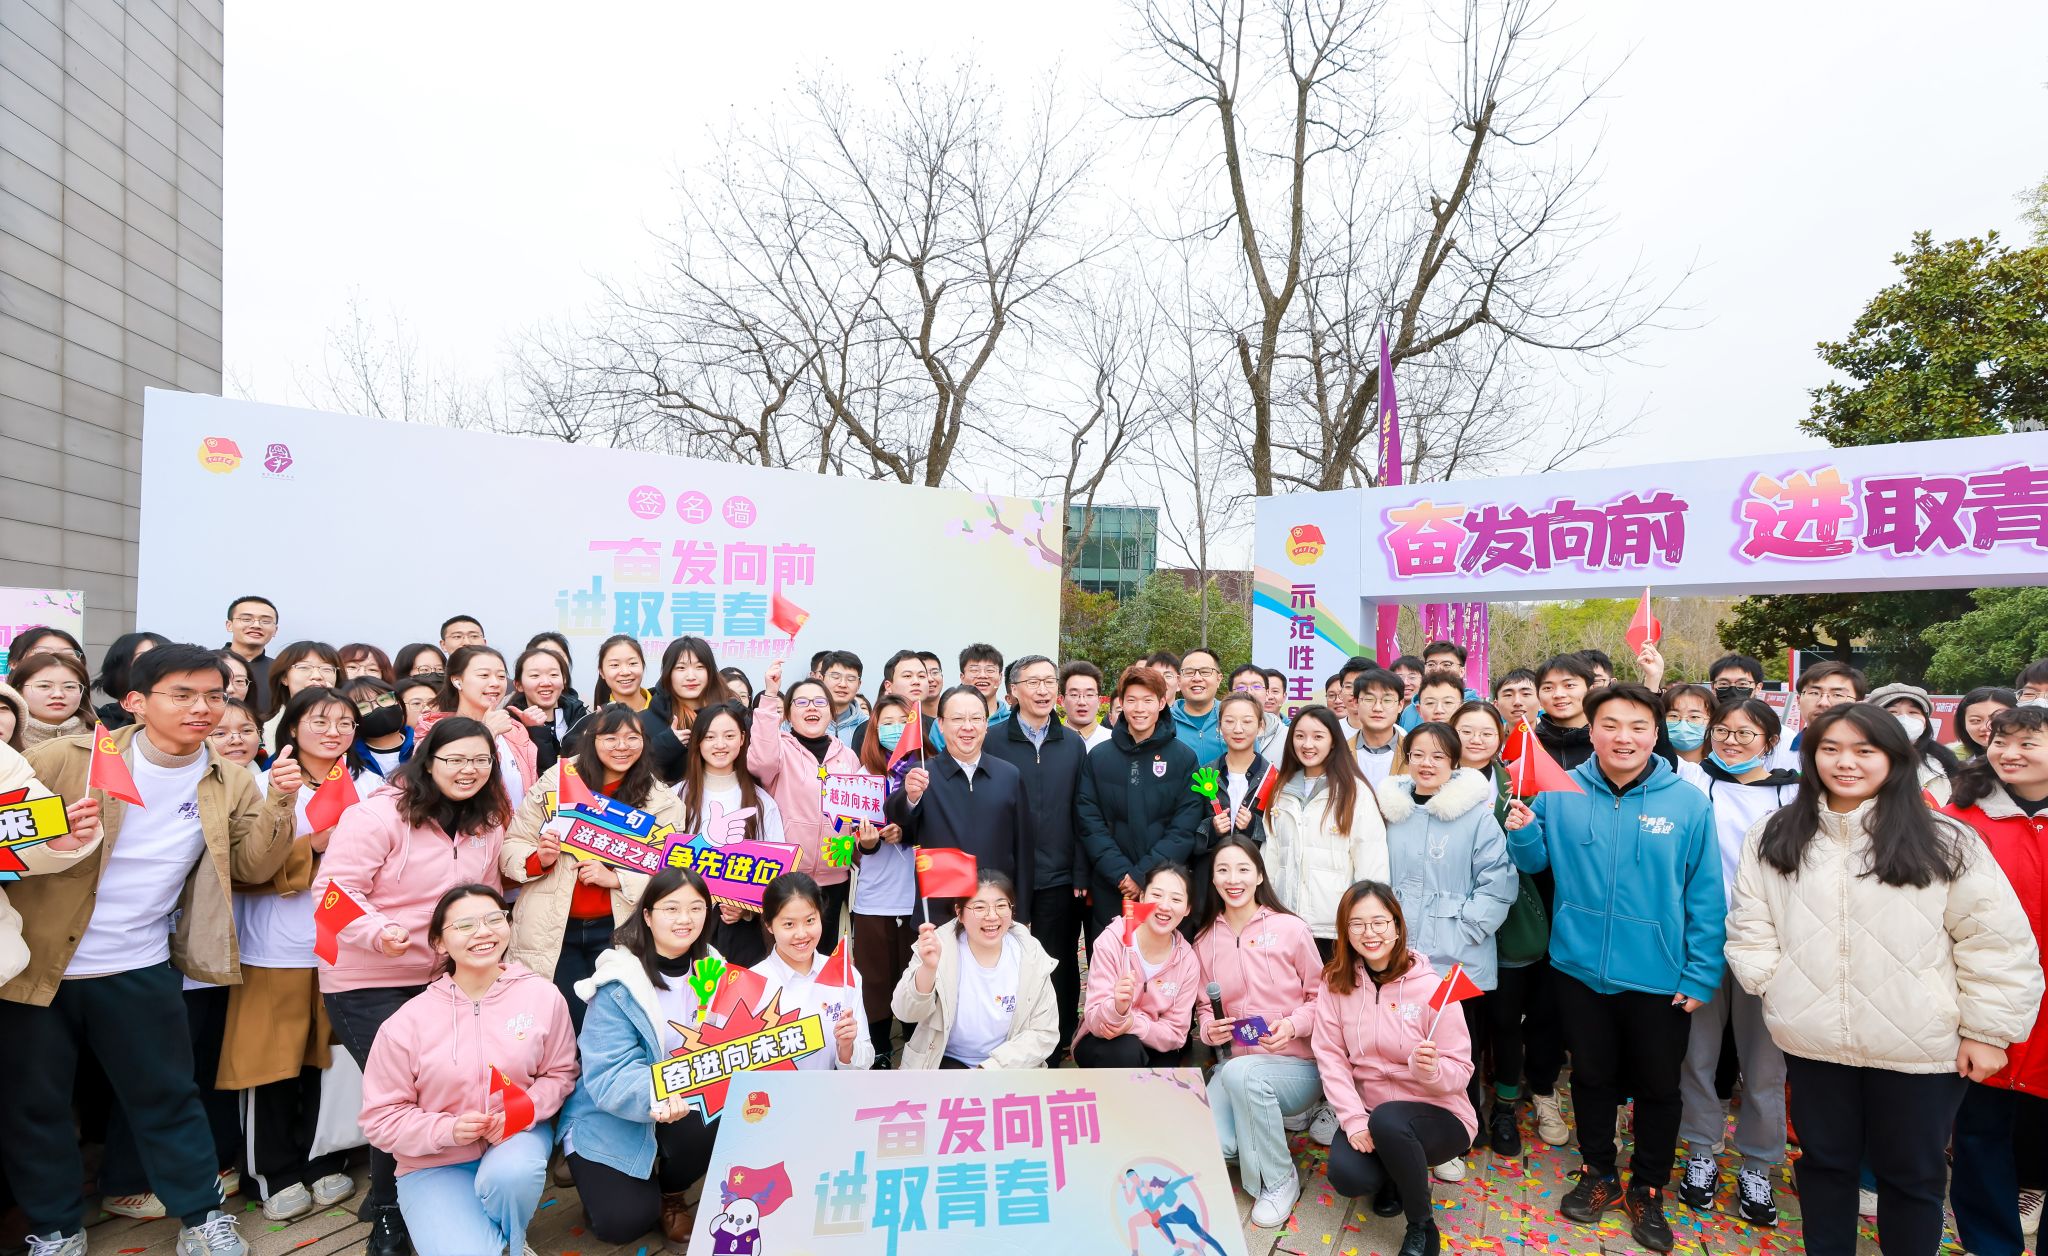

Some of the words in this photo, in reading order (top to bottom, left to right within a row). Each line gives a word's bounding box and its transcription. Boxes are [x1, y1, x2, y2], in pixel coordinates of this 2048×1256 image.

[636, 489, 752, 526] 签名墙
[1388, 491, 1689, 576] 奋发向前
[1740, 464, 2048, 559] 进取青
[589, 537, 816, 597] 奋发向前
[555, 576, 769, 638] 进取青春
[830, 788, 881, 813] 越动向未来
[667, 844, 782, 885] 争先进位
[662, 1025, 807, 1094] 奋进向未来
[854, 1087, 1102, 1191] 奋发向前
[812, 1150, 1051, 1256] 进取青春
